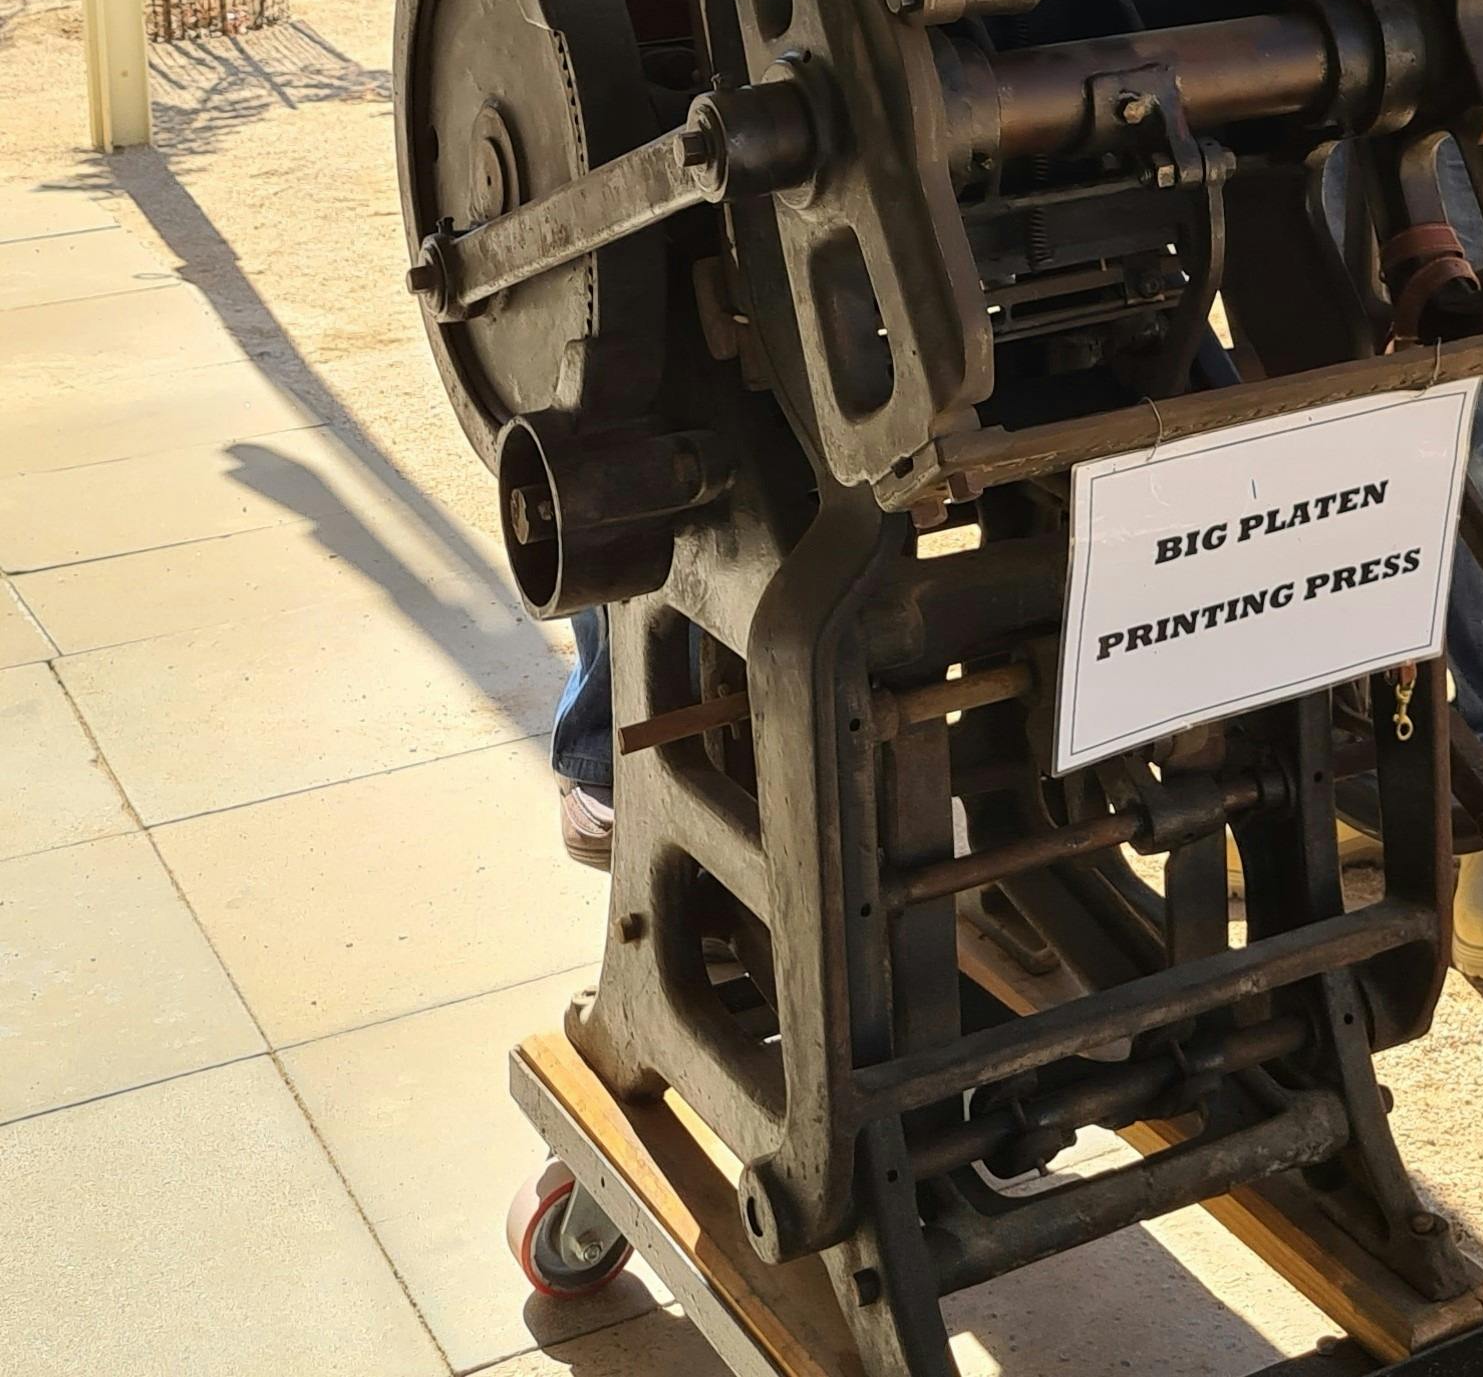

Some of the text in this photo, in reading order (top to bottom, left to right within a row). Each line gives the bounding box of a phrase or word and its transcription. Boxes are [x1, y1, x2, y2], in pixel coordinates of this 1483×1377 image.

[1154, 480, 1389, 564] BIG PLATEN
[1096, 548, 1421, 661] PRINTING PRESS
